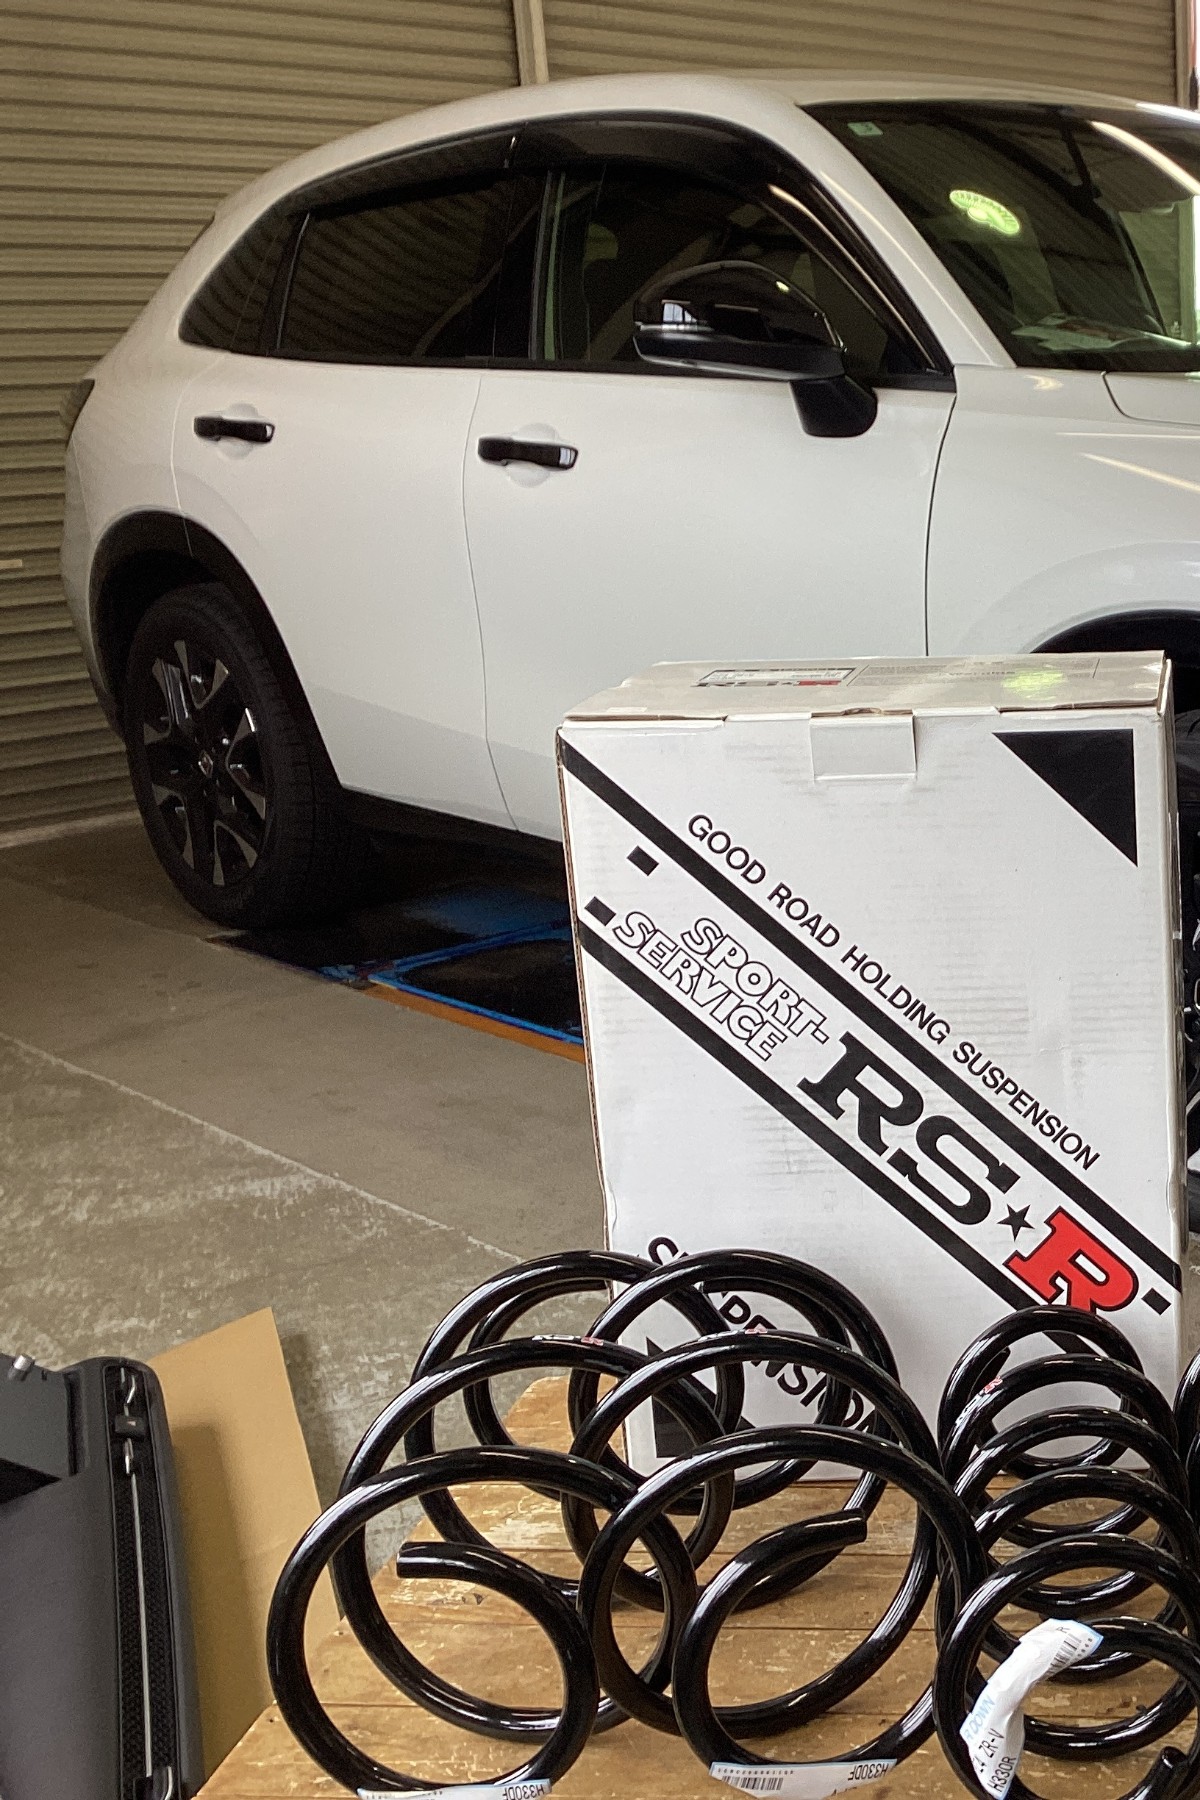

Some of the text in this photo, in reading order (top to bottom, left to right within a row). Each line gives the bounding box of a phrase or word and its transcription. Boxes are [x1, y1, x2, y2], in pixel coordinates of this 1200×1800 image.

[612, 910, 789, 1063] SERVICE
[687, 813, 1100, 1171] GOOD ROAD HOLDING SUSPENSION
[978, 1728, 1005, 1758] ZR-V
[847, 1763, 890, 1781] H330DF
[987, 1756, 1017, 1792] H330R
[501, 1784, 546, 1800] H330DF
